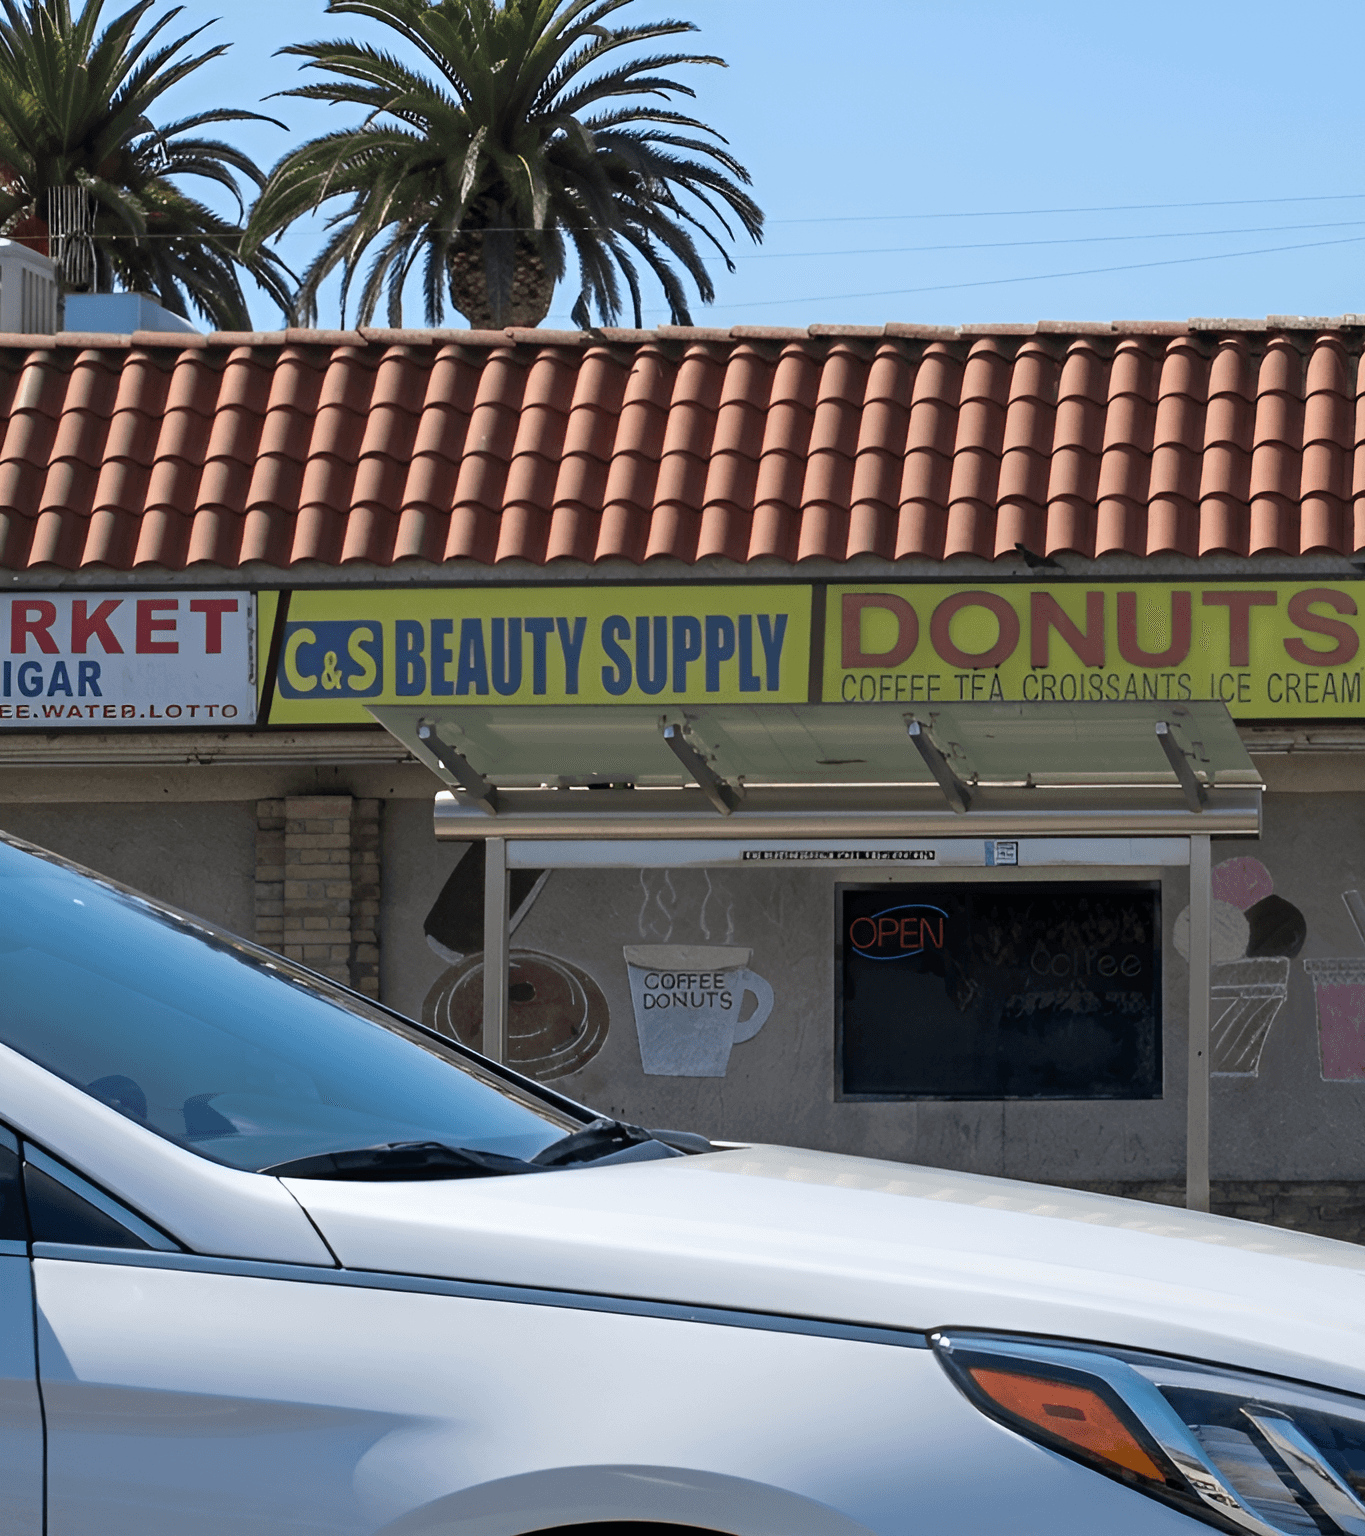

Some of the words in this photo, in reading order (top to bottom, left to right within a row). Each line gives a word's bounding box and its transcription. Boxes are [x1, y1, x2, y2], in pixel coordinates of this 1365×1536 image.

[10, 599, 239, 654] RKET
[841, 587, 1360, 669] DONUTS
[284, 627, 377, 692] C&S
[395, 616, 587, 697] BEAUTY
[601, 612, 789, 696] SUPPLY
[3, 661, 103, 697] IGAR
[841, 674, 941, 702] COFFEE
[954, 673, 1005, 700] TEA
[1022, 673, 1192, 701] CROISSANTS
[1210, 673, 1252, 703] ICE
[1267, 672, 1361, 703] CREAM
[850, 917, 944, 949] OPEN
[644, 972, 725, 990] COFFEE
[643, 991, 733, 1010] DONUTS
